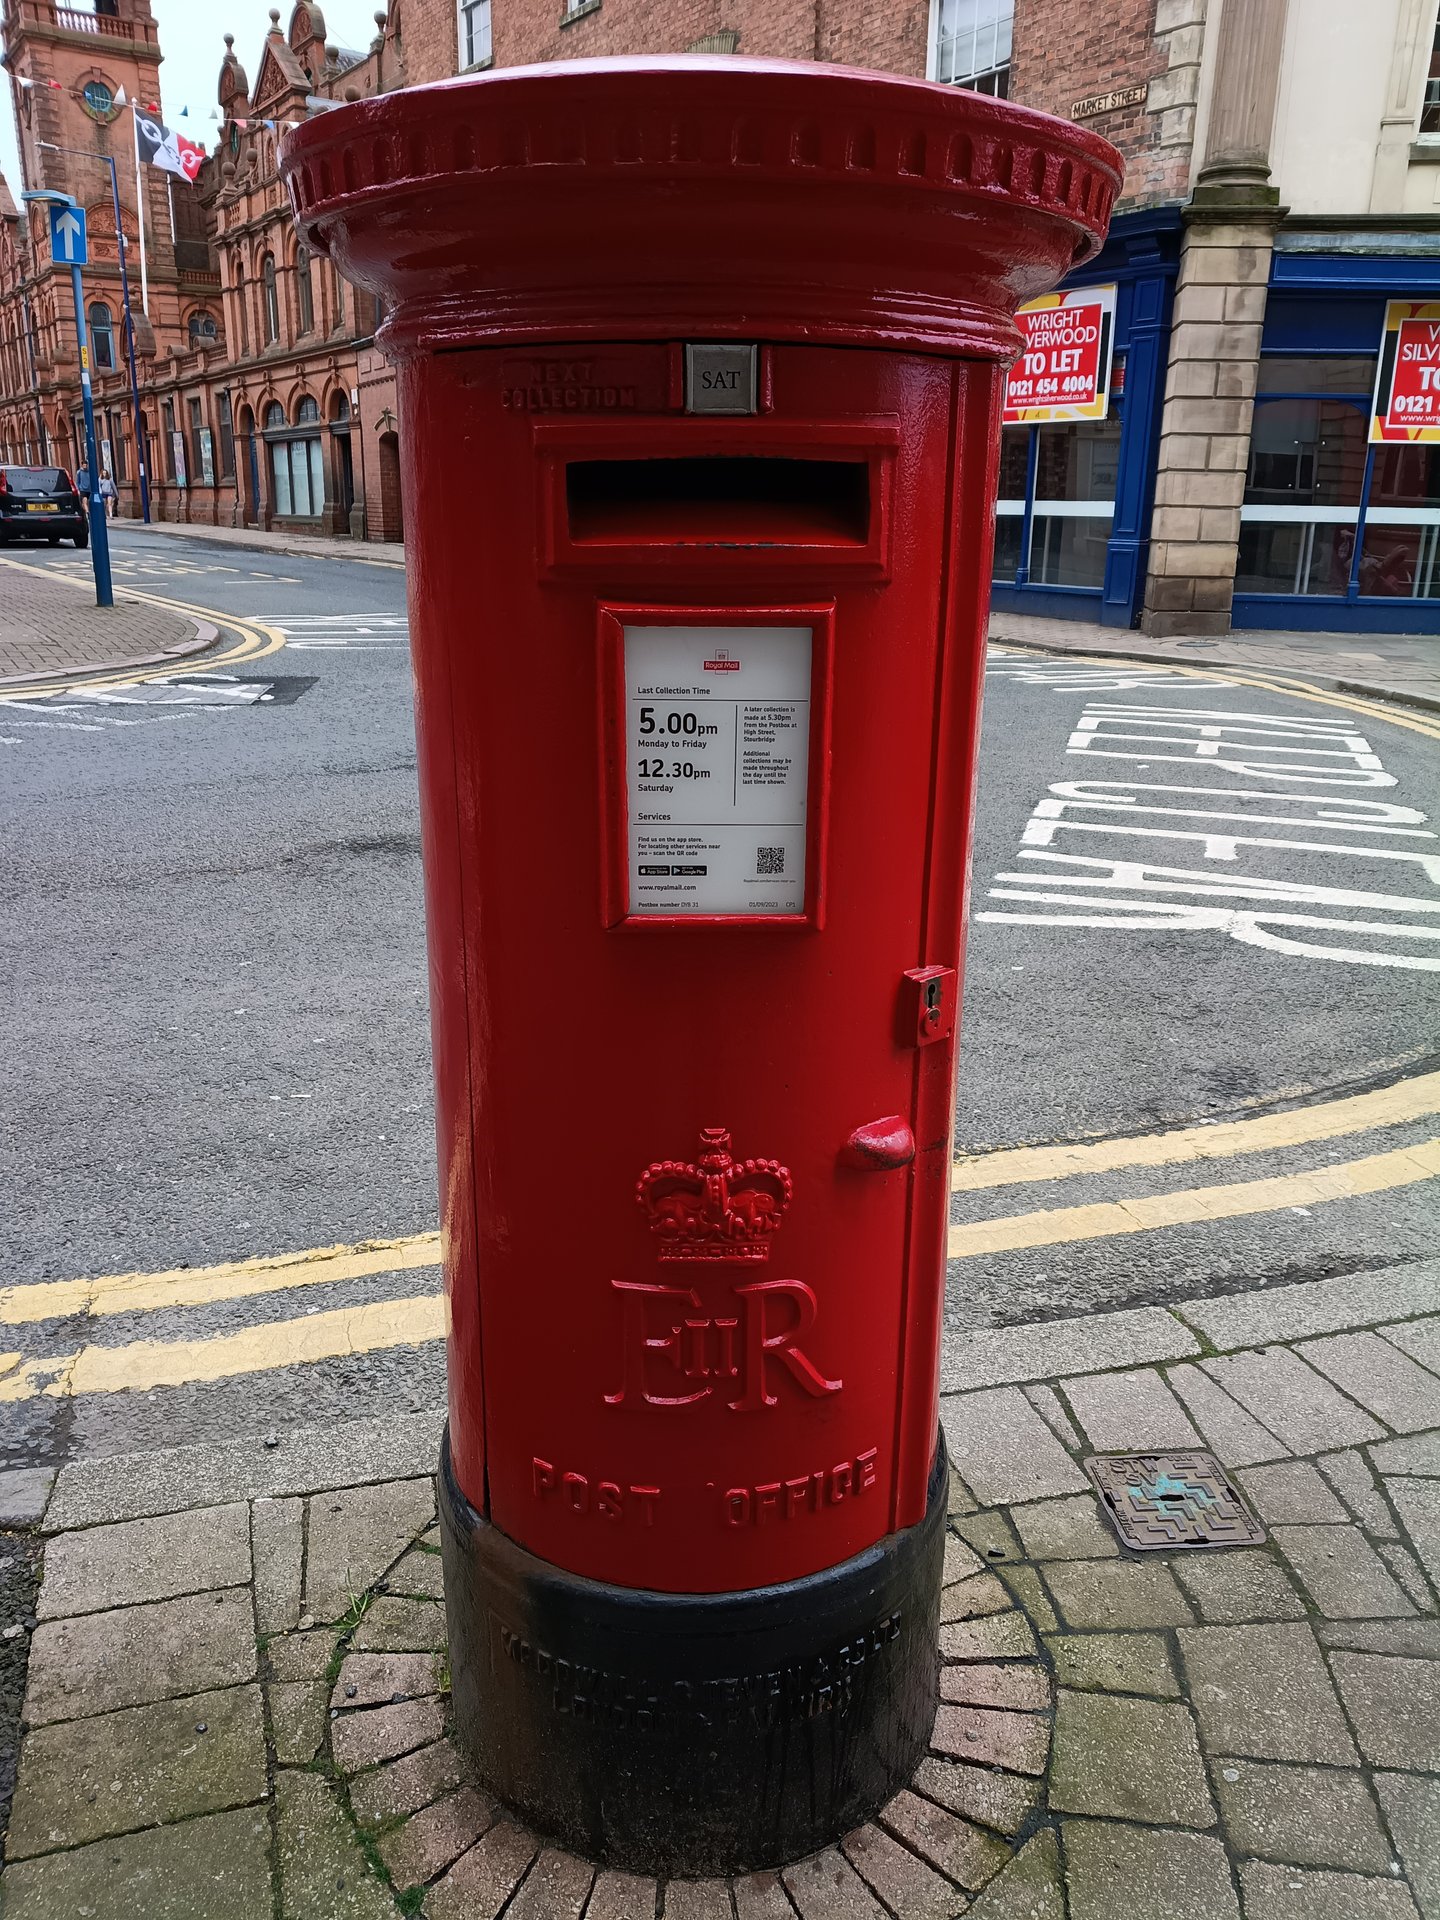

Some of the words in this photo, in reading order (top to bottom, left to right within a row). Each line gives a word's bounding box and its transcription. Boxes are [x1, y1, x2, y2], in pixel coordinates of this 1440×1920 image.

[1072, 95, 1109, 118] MARKET
[1111, 86, 1145, 107] STREET
[1027, 309, 1084, 332] WRIGHT
[1023, 326, 1098, 349] VERWOOD
[1023, 352, 1046, 375] TO
[1050, 348, 1083, 374] LET
[1402, 343, 1440, 361] SILV
[529, 362, 594, 382] NEXT
[702, 370, 741, 390] SAT
[1009, 379, 1033, 397] 0121
[1036, 377, 1058, 394] 454
[1062, 374, 1094, 392] 4004
[501, 387, 636, 408] COLLECTION
[1395, 395, 1434, 413] 0121
[705, 662, 723, 670] Royal
[655, 686, 690, 694] Collection
[640, 708, 718, 736] 5.00pm
[638, 740, 670, 749] Monday
[682, 740, 707, 750] Friday
[1065, 703, 1399, 787] KEEP
[638, 759, 710, 780] 12.30pm
[638, 784, 674, 792] Saturday
[638, 812, 671, 820] Services
[532, 1457, 661, 1527] POST
[725, 1447, 878, 1527] OFFICE
